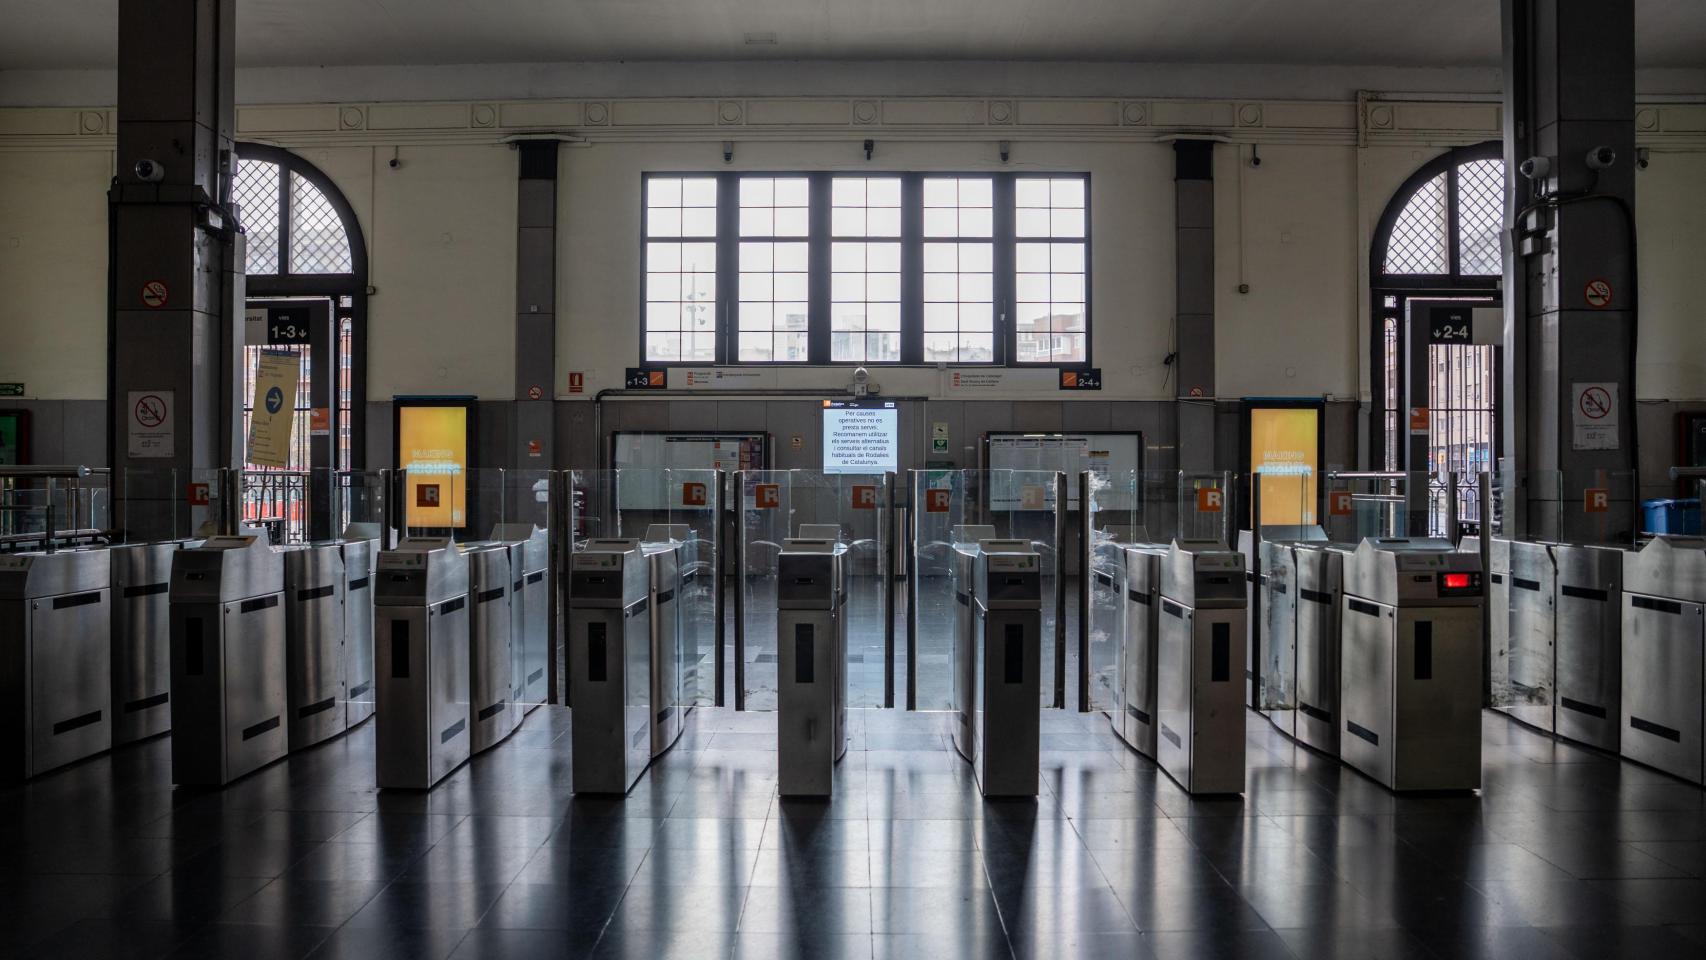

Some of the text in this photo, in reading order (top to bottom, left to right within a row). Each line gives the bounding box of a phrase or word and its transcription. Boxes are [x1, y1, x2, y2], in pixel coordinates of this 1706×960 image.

[271, 325, 296, 339] 1-3
[1443, 325, 1468, 339] 2-4
[633, 377, 648, 386] 1-3
[1078, 378, 1094, 387] 2-4
[425, 487, 439, 502] R
[691, 485, 706, 500] R
[764, 488, 778, 502] R
[861, 489, 875, 504] R
[935, 492, 949, 506] R
[1206, 491, 1221, 507] R
[1338, 495, 1352, 510] R
[1593, 493, 1608, 507] R
